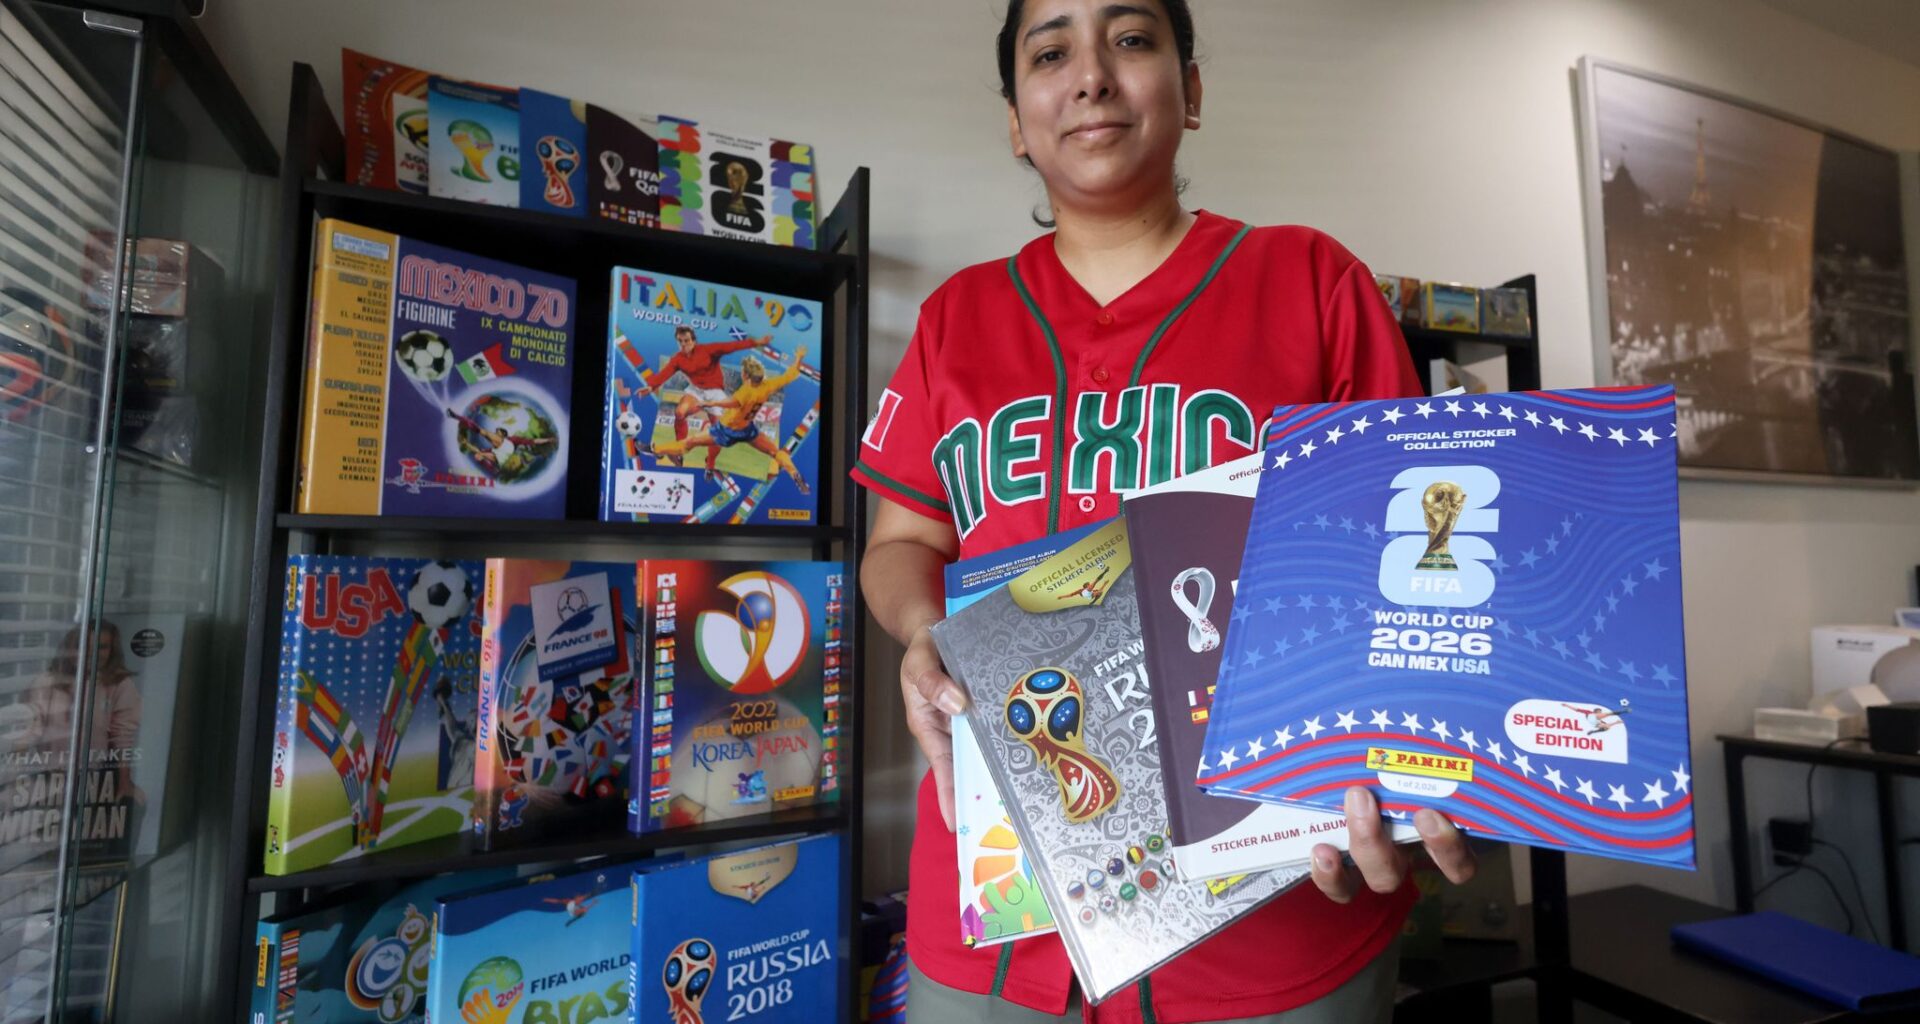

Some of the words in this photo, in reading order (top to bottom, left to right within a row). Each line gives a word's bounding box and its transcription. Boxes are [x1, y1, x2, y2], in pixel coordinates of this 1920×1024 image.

[726, 213, 752, 226] FIFA
[401, 255, 525, 319] MEXICO
[527, 284, 568, 327] 70
[620, 272, 748, 323] ITALIA
[397, 299, 456, 329] FIGURINE
[632, 308, 683, 326] WORLD
[690, 318, 718, 332] CUP
[481, 316, 493, 329] IX
[499, 320, 567, 343] CAMPIONATO
[511, 335, 566, 355] MONDIALE
[510, 349, 521, 360] DI
[527, 350, 566, 367] CALCIO
[1386, 431, 1450, 442] OFFICIAL
[1453, 428, 1516, 439] STICKER
[1404, 439, 1496, 451] COLLECTION
[932, 383, 1272, 542] MEXIC
[1228, 466, 1263, 481] Official
[962, 569, 986, 580] OFFICIAL
[987, 561, 1013, 573] LICENSED
[1013, 554, 1036, 566] STICKER
[1037, 549, 1056, 559] ALBUM
[1029, 563, 1075, 593] OFFICIAL
[1076, 534, 1124, 566] LICENSED
[1046, 567, 1084, 593] STICKER
[1085, 549, 1118, 571] ALBUM
[962, 580, 982, 589] ALBUM
[1410, 576, 1462, 593] FIFA
[302, 567, 406, 639] USA
[1374, 610, 1447, 627] WORLD
[1450, 615, 1494, 630] CUP
[484, 639, 492, 662] 98
[544, 633, 592, 653] FRANCE
[593, 628, 608, 639] 98
[1370, 627, 1493, 656] 2026
[1093, 651, 1131, 677] FIFA
[1368, 652, 1406, 668] CAN
[1407, 655, 1449, 672] MEX
[1451, 658, 1491, 675] USA
[479, 671, 492, 751] FRANCE
[730, 700, 776, 721] 2002
[1513, 713, 1583, 732] SPECIAL
[693, 725, 725, 741] FIFA
[729, 719, 780, 737] WORLD
[784, 716, 809, 730] CUP
[89, 748, 143, 761] TAKES
[692, 742, 755, 772] KOREA
[755, 735, 809, 769] JAPAN
[1535, 733, 1603, 751] EDITION
[1396, 753, 1469, 772] PANINI
[13, 770, 115, 808] SARNA
[1403, 780, 1414, 789] of
[1415, 781, 1438, 792] 2,026
[1211, 836, 1258, 854] STICKER
[1260, 828, 1301, 845] ALBUM
[727, 949, 751, 961] FIFA
[752, 935, 789, 954] WORLD
[790, 929, 810, 943] CUP
[530, 972, 568, 994] FIFA
[570, 953, 632, 982] WORLD
[727, 939, 832, 991] RUSSIA
[522, 979, 630, 1024] Bras
[727, 979, 793, 1021] 2018
